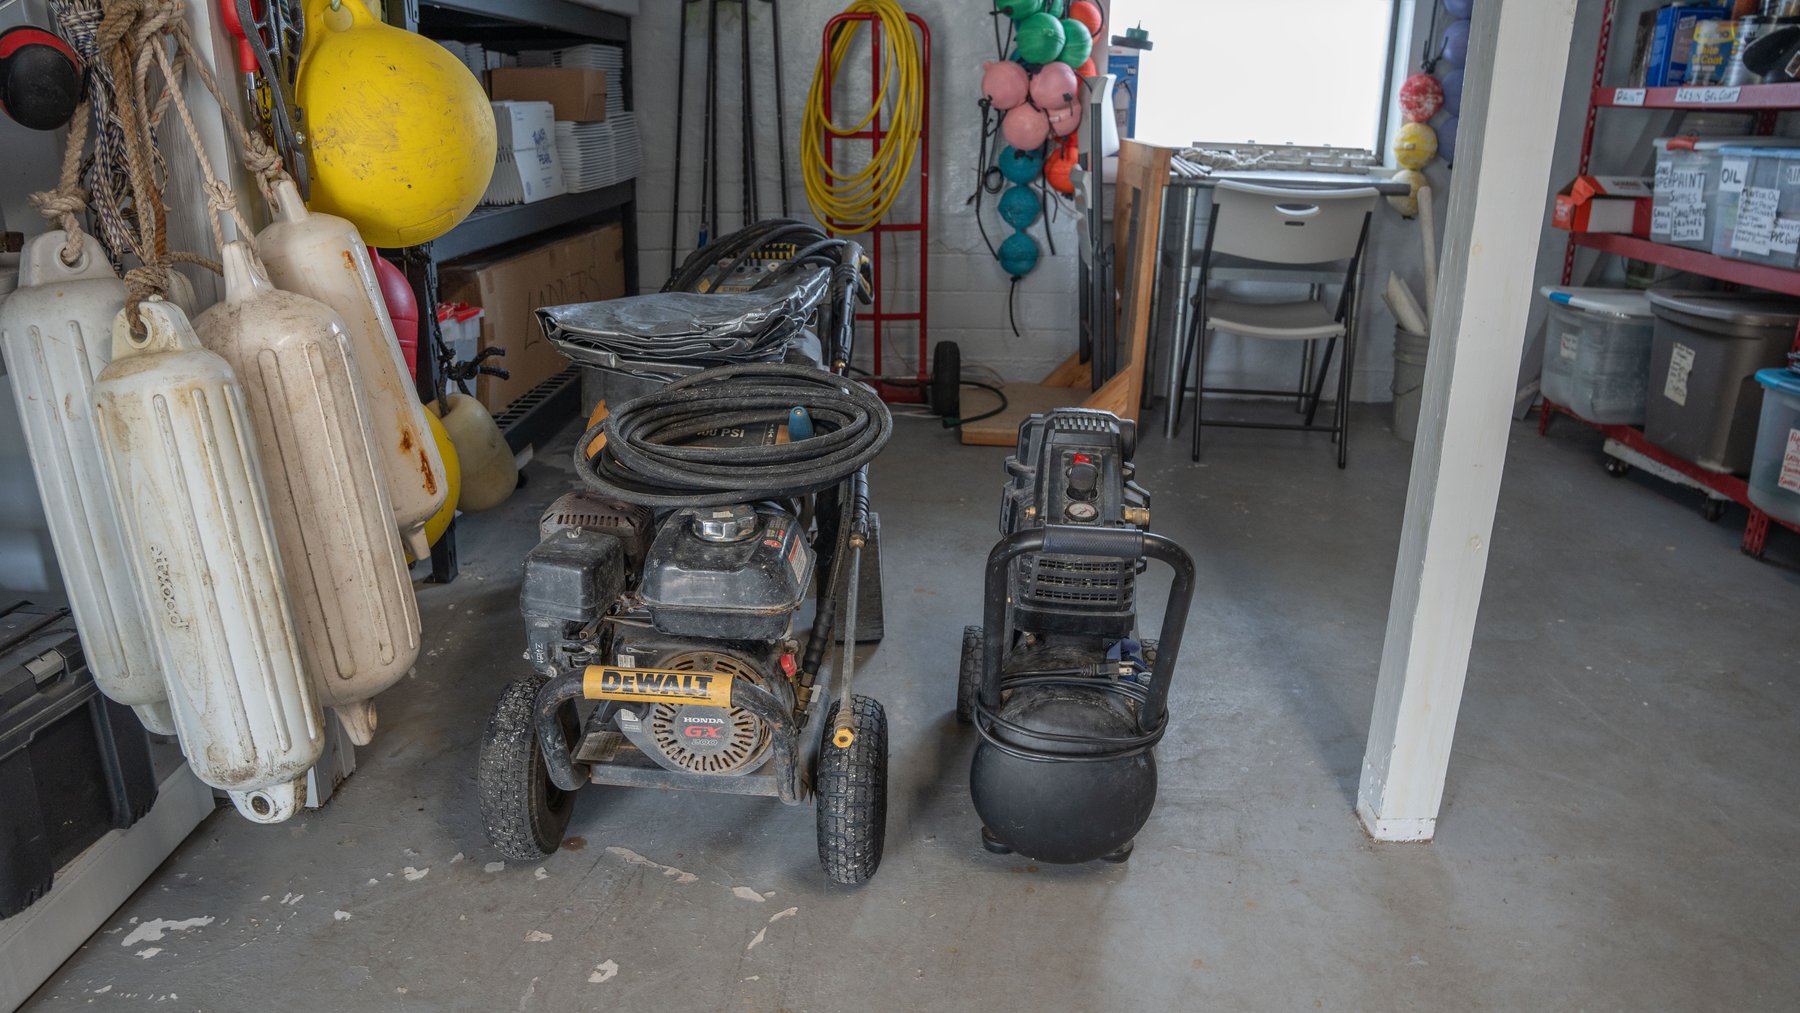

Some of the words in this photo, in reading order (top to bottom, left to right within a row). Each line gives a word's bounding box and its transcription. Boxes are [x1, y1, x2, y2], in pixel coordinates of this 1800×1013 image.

[1672, 172, 1705, 189] PAINT
[1721, 168, 1742, 184] OIL
[721, 428, 745, 438] PSI
[602, 670, 713, 697] DEWALT
[684, 725, 723, 739] GX
